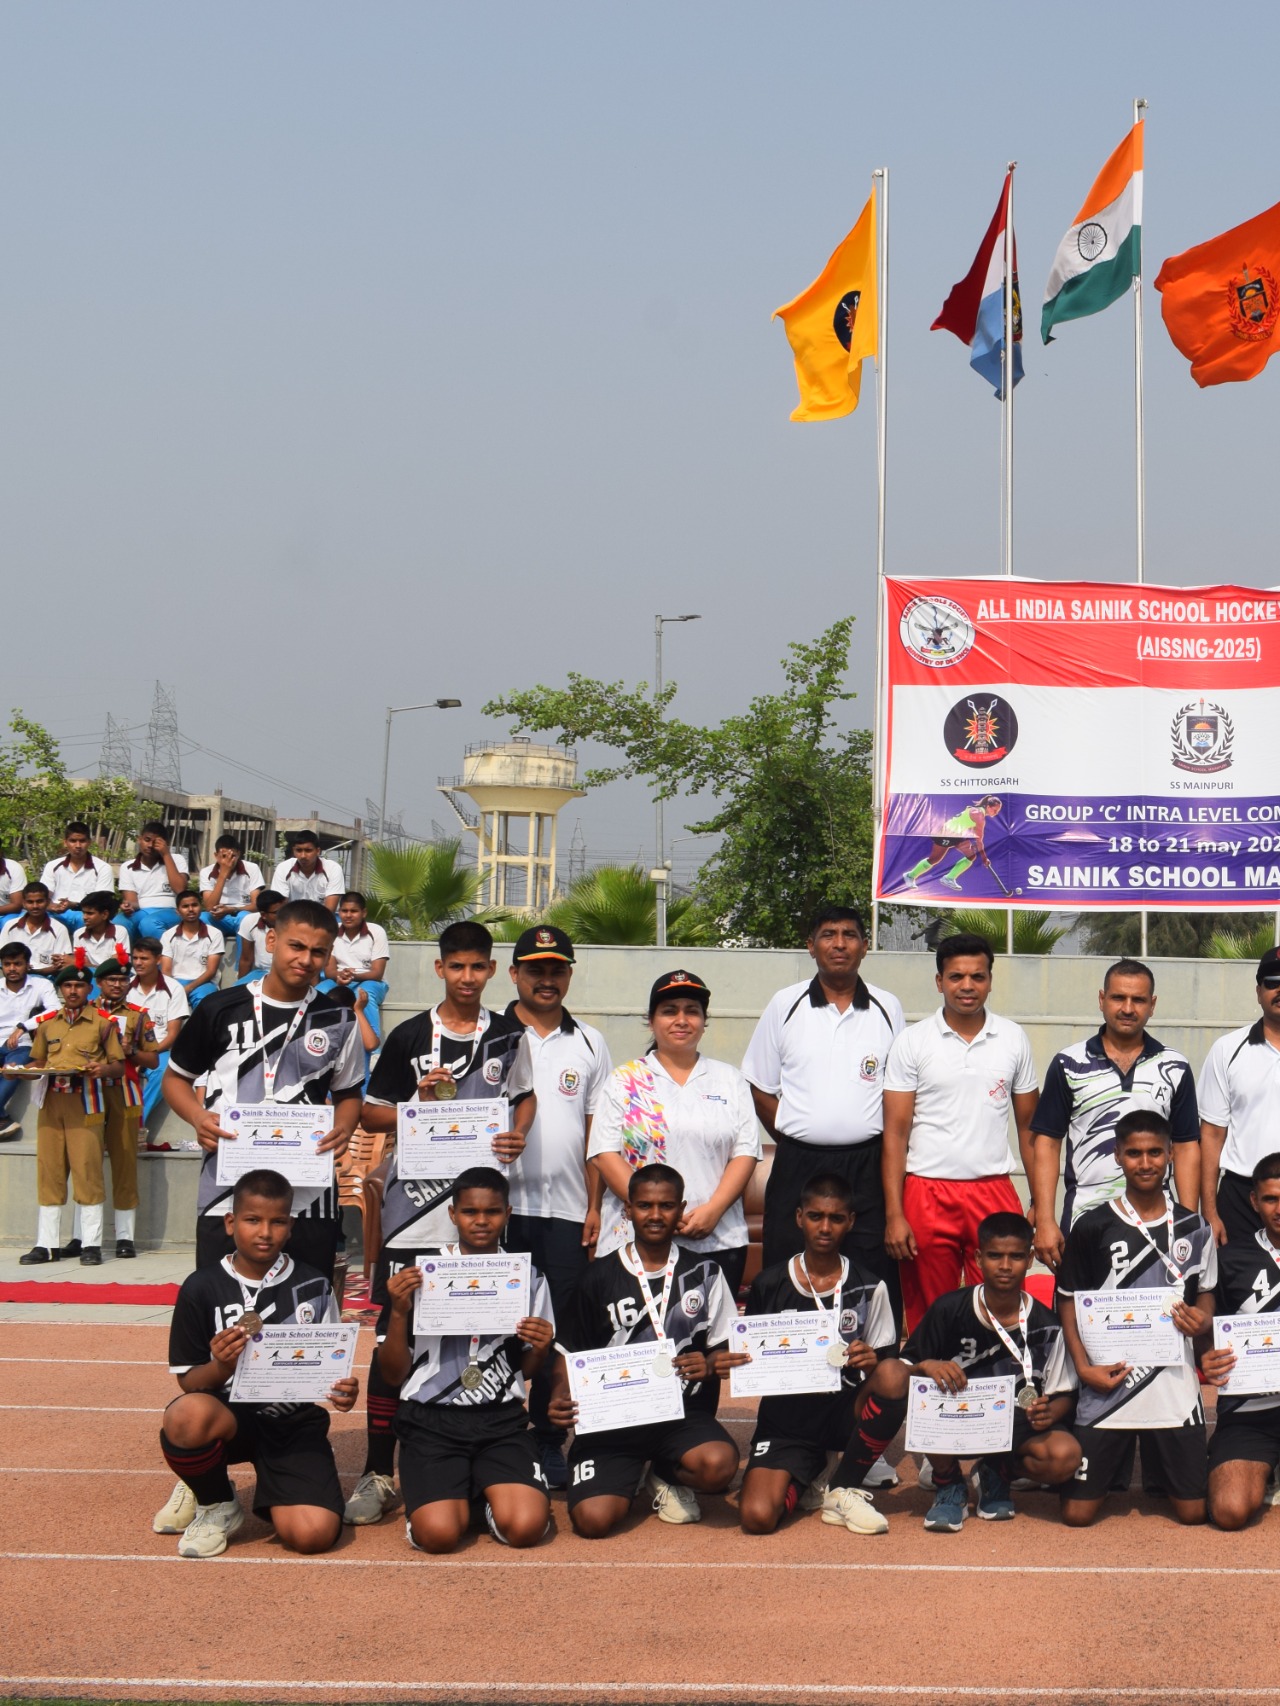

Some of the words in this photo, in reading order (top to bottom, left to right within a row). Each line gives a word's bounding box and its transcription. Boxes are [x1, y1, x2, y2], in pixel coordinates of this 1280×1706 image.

[977, 599, 1010, 619] ALL
[1015, 599, 1066, 620] INDIA
[1070, 600, 1133, 620] SAINIK
[1138, 600, 1210, 622] SCHOOL
[1137, 635, 1261, 662] (AISSNG-2025)
[940, 779, 951, 787] SS
[954, 777, 1019, 787] CHITTORGARH
[1170, 781, 1180, 789] SS
[1183, 781, 1234, 790] MAINPURI
[1025, 804, 1093, 821] GROUP
[1127, 805, 1183, 822] INTRA
[1188, 807, 1242, 822] LEVEL
[1108, 837, 1132, 853] 18
[1138, 837, 1160, 853] to
[1166, 837, 1190, 853] 21
[1197, 841, 1242, 857] may
[1027, 865, 1121, 887] SAINIK
[1128, 866, 1236, 887] SCHOOL
[226, 1019, 257, 1050] 11
[291, 1111, 316, 1119] Society
[466, 1105, 489, 1114] Society
[1110, 1240, 1130, 1270] 2
[1252, 1269, 1271, 1296] 4
[1139, 1294, 1162, 1302] Society
[607, 1296, 638, 1331] 16
[795, 1318, 818, 1326] Society
[264, 1331, 287, 1339] Sainik
[288, 1331, 313, 1339] School
[314, 1331, 339, 1339] Society
[586, 1356, 607, 1364] Sainik
[608, 1352, 632, 1361] School
[633, 1349, 656, 1358] Society
[959, 1337, 977, 1360] 3
[975, 1384, 998, 1392] Society
[754, 1441, 770, 1457] 5
[573, 1460, 595, 1486] 16
[1075, 1457, 1088, 1481] 2
